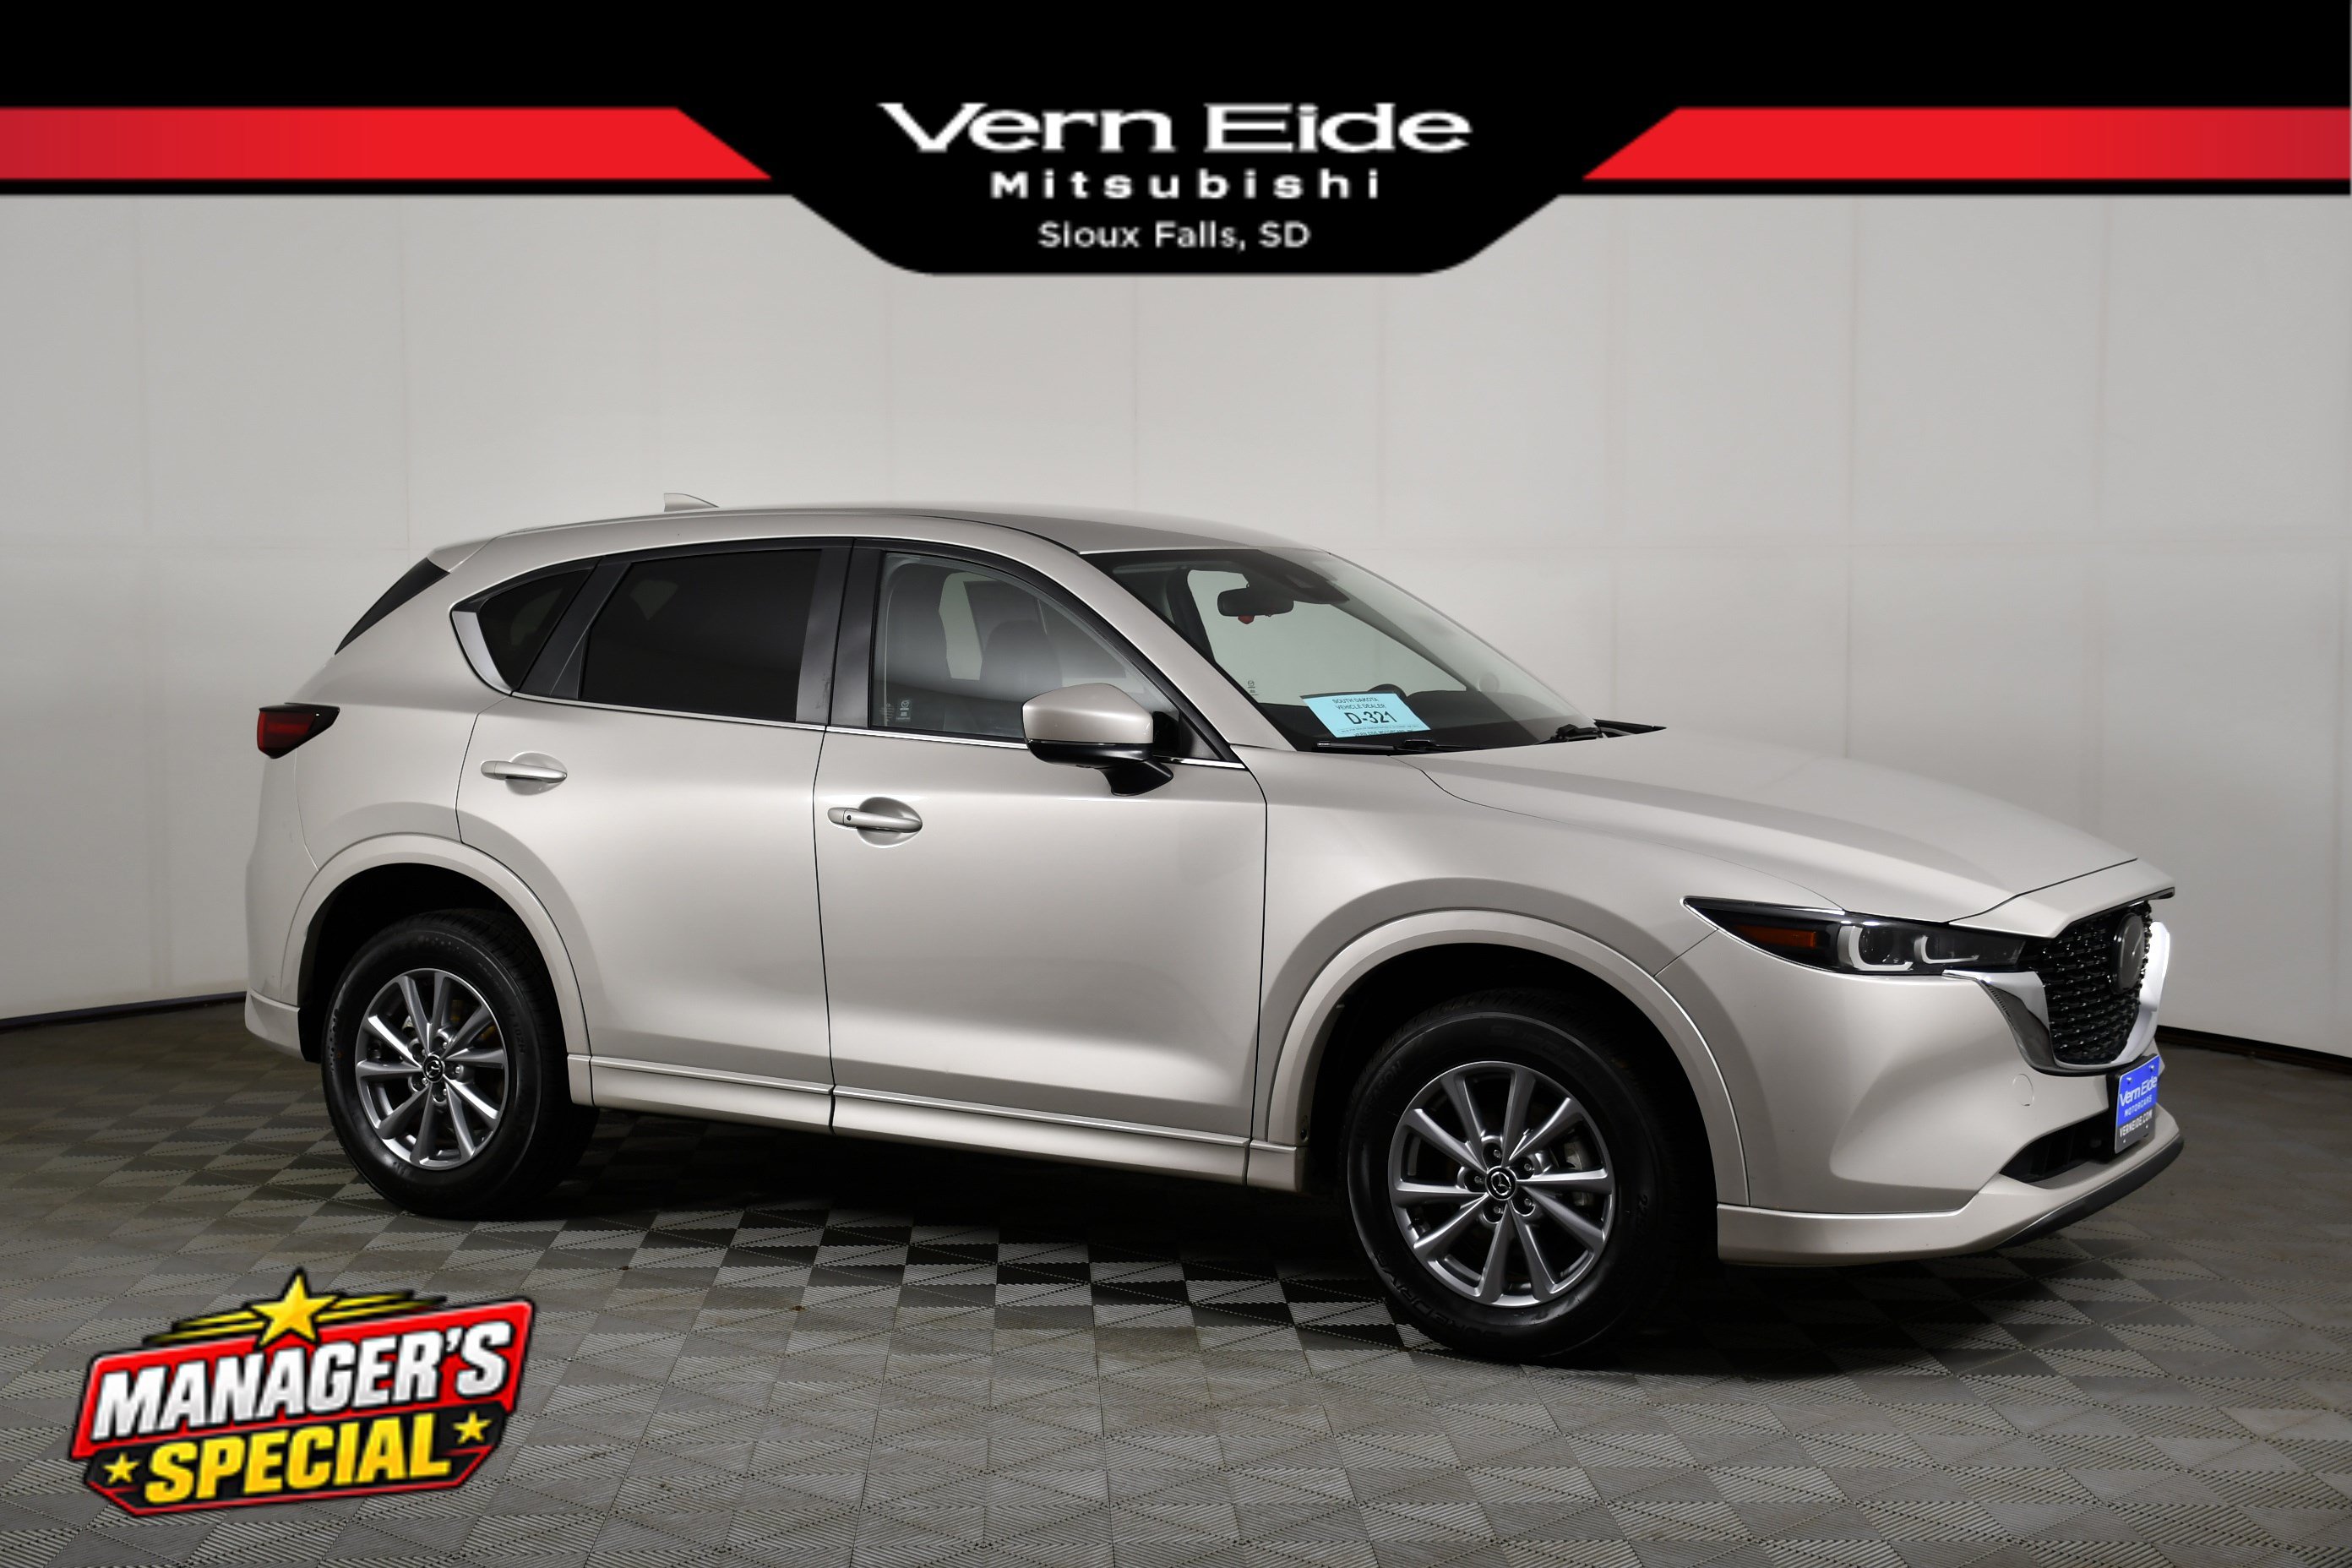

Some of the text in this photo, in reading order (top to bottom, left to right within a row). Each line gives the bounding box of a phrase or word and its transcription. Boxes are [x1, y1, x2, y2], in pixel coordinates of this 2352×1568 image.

[1344, 710, 1397, 724] D-321
[2120, 1075, 2158, 1106] Vern Eide
